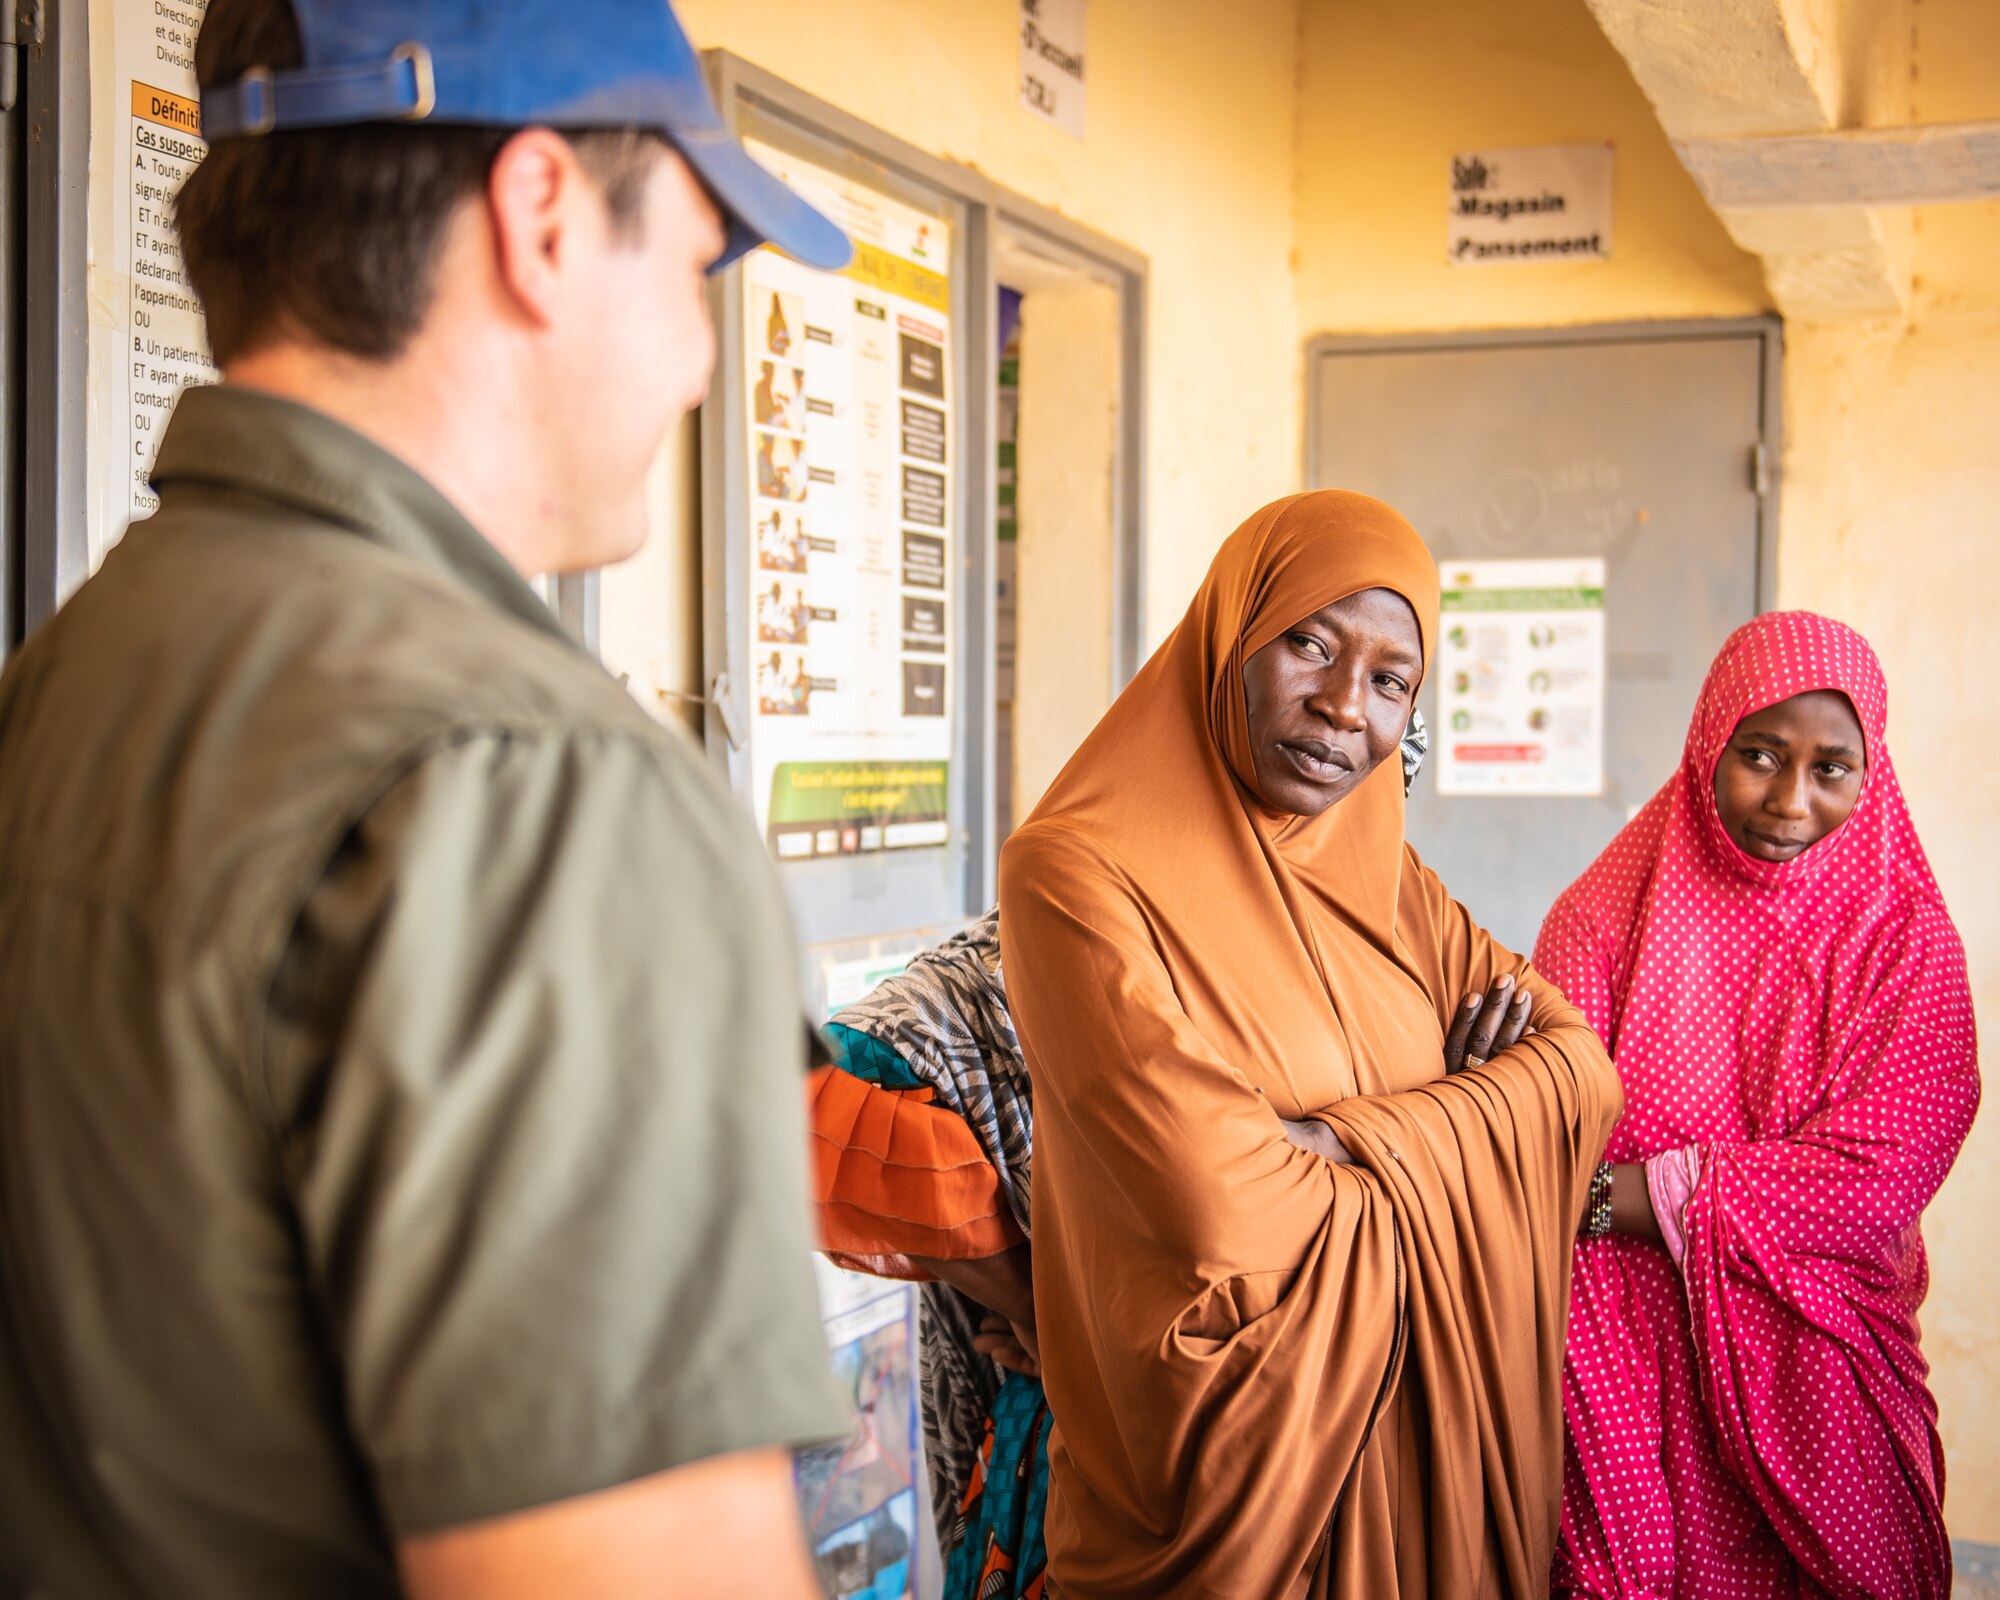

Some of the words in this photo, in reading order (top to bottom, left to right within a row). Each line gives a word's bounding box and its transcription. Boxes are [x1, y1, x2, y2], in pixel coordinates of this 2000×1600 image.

[155, 1, 200, 29] Direction
[155, 26, 166, 40] et
[168, 29, 181, 45] de
[183, 33, 192, 48] la
[156, 45, 196, 72] Division
[151, 96, 201, 129] Définiti
[136, 125, 156, 147] Cas
[135, 153, 146, 171] A.
[152, 158, 182, 181] Toute
[139, 207, 151, 224] ET
[136, 232, 148, 248] ET
[151, 239, 179, 257] ayant
[135, 258, 182, 285] déclarant
[134, 283, 190, 312] l'apparition
[134, 310, 150, 328] OU
[133, 337, 144, 353] B.
[147, 339, 161, 356] Un
[163, 346, 199, 364] patient
[133, 363, 146, 378] ET
[150, 368, 178, 386] ayant
[183, 372, 199, 387] été
[134, 391, 175, 410] contact)
[134, 414, 151, 431] OU
[135, 440, 145, 456] C.
[134, 466, 151, 487] sig
[134, 491, 161, 511] hosp
